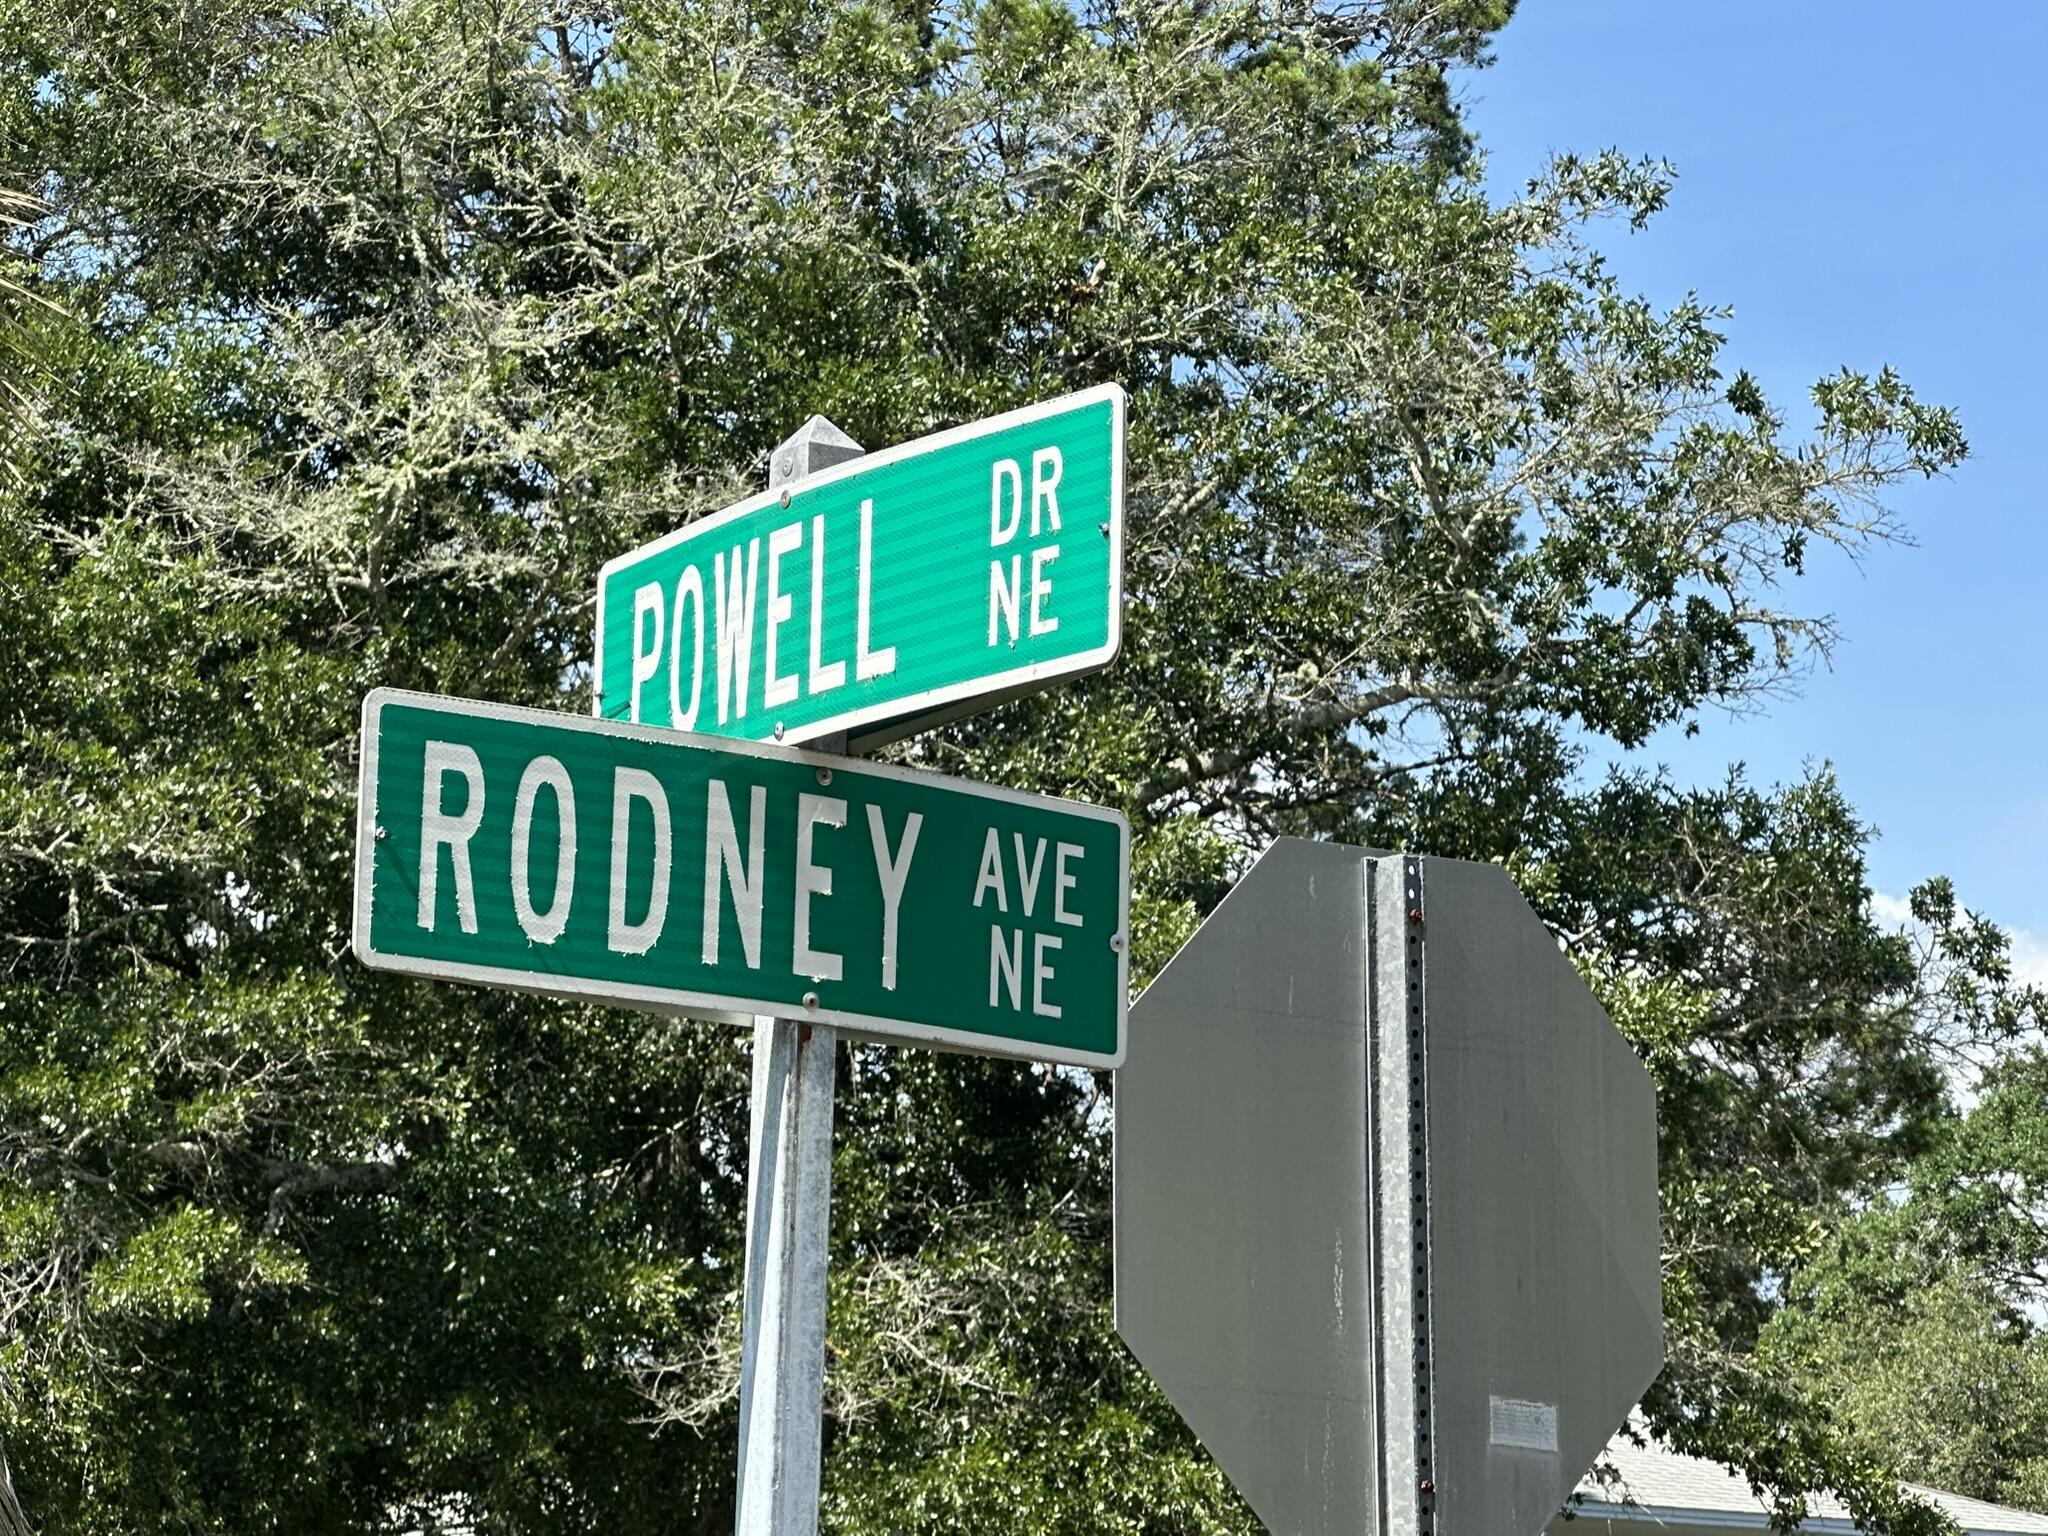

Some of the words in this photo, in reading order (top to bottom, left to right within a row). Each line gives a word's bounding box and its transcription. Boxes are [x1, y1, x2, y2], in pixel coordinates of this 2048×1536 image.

[631, 498, 896, 731] POWELL
[990, 446, 1063, 547] DR
[988, 544, 1060, 647] NE
[416, 740, 923, 991] RODNEY
[973, 827, 1085, 928] AVE
[989, 924, 1063, 1019] NE
